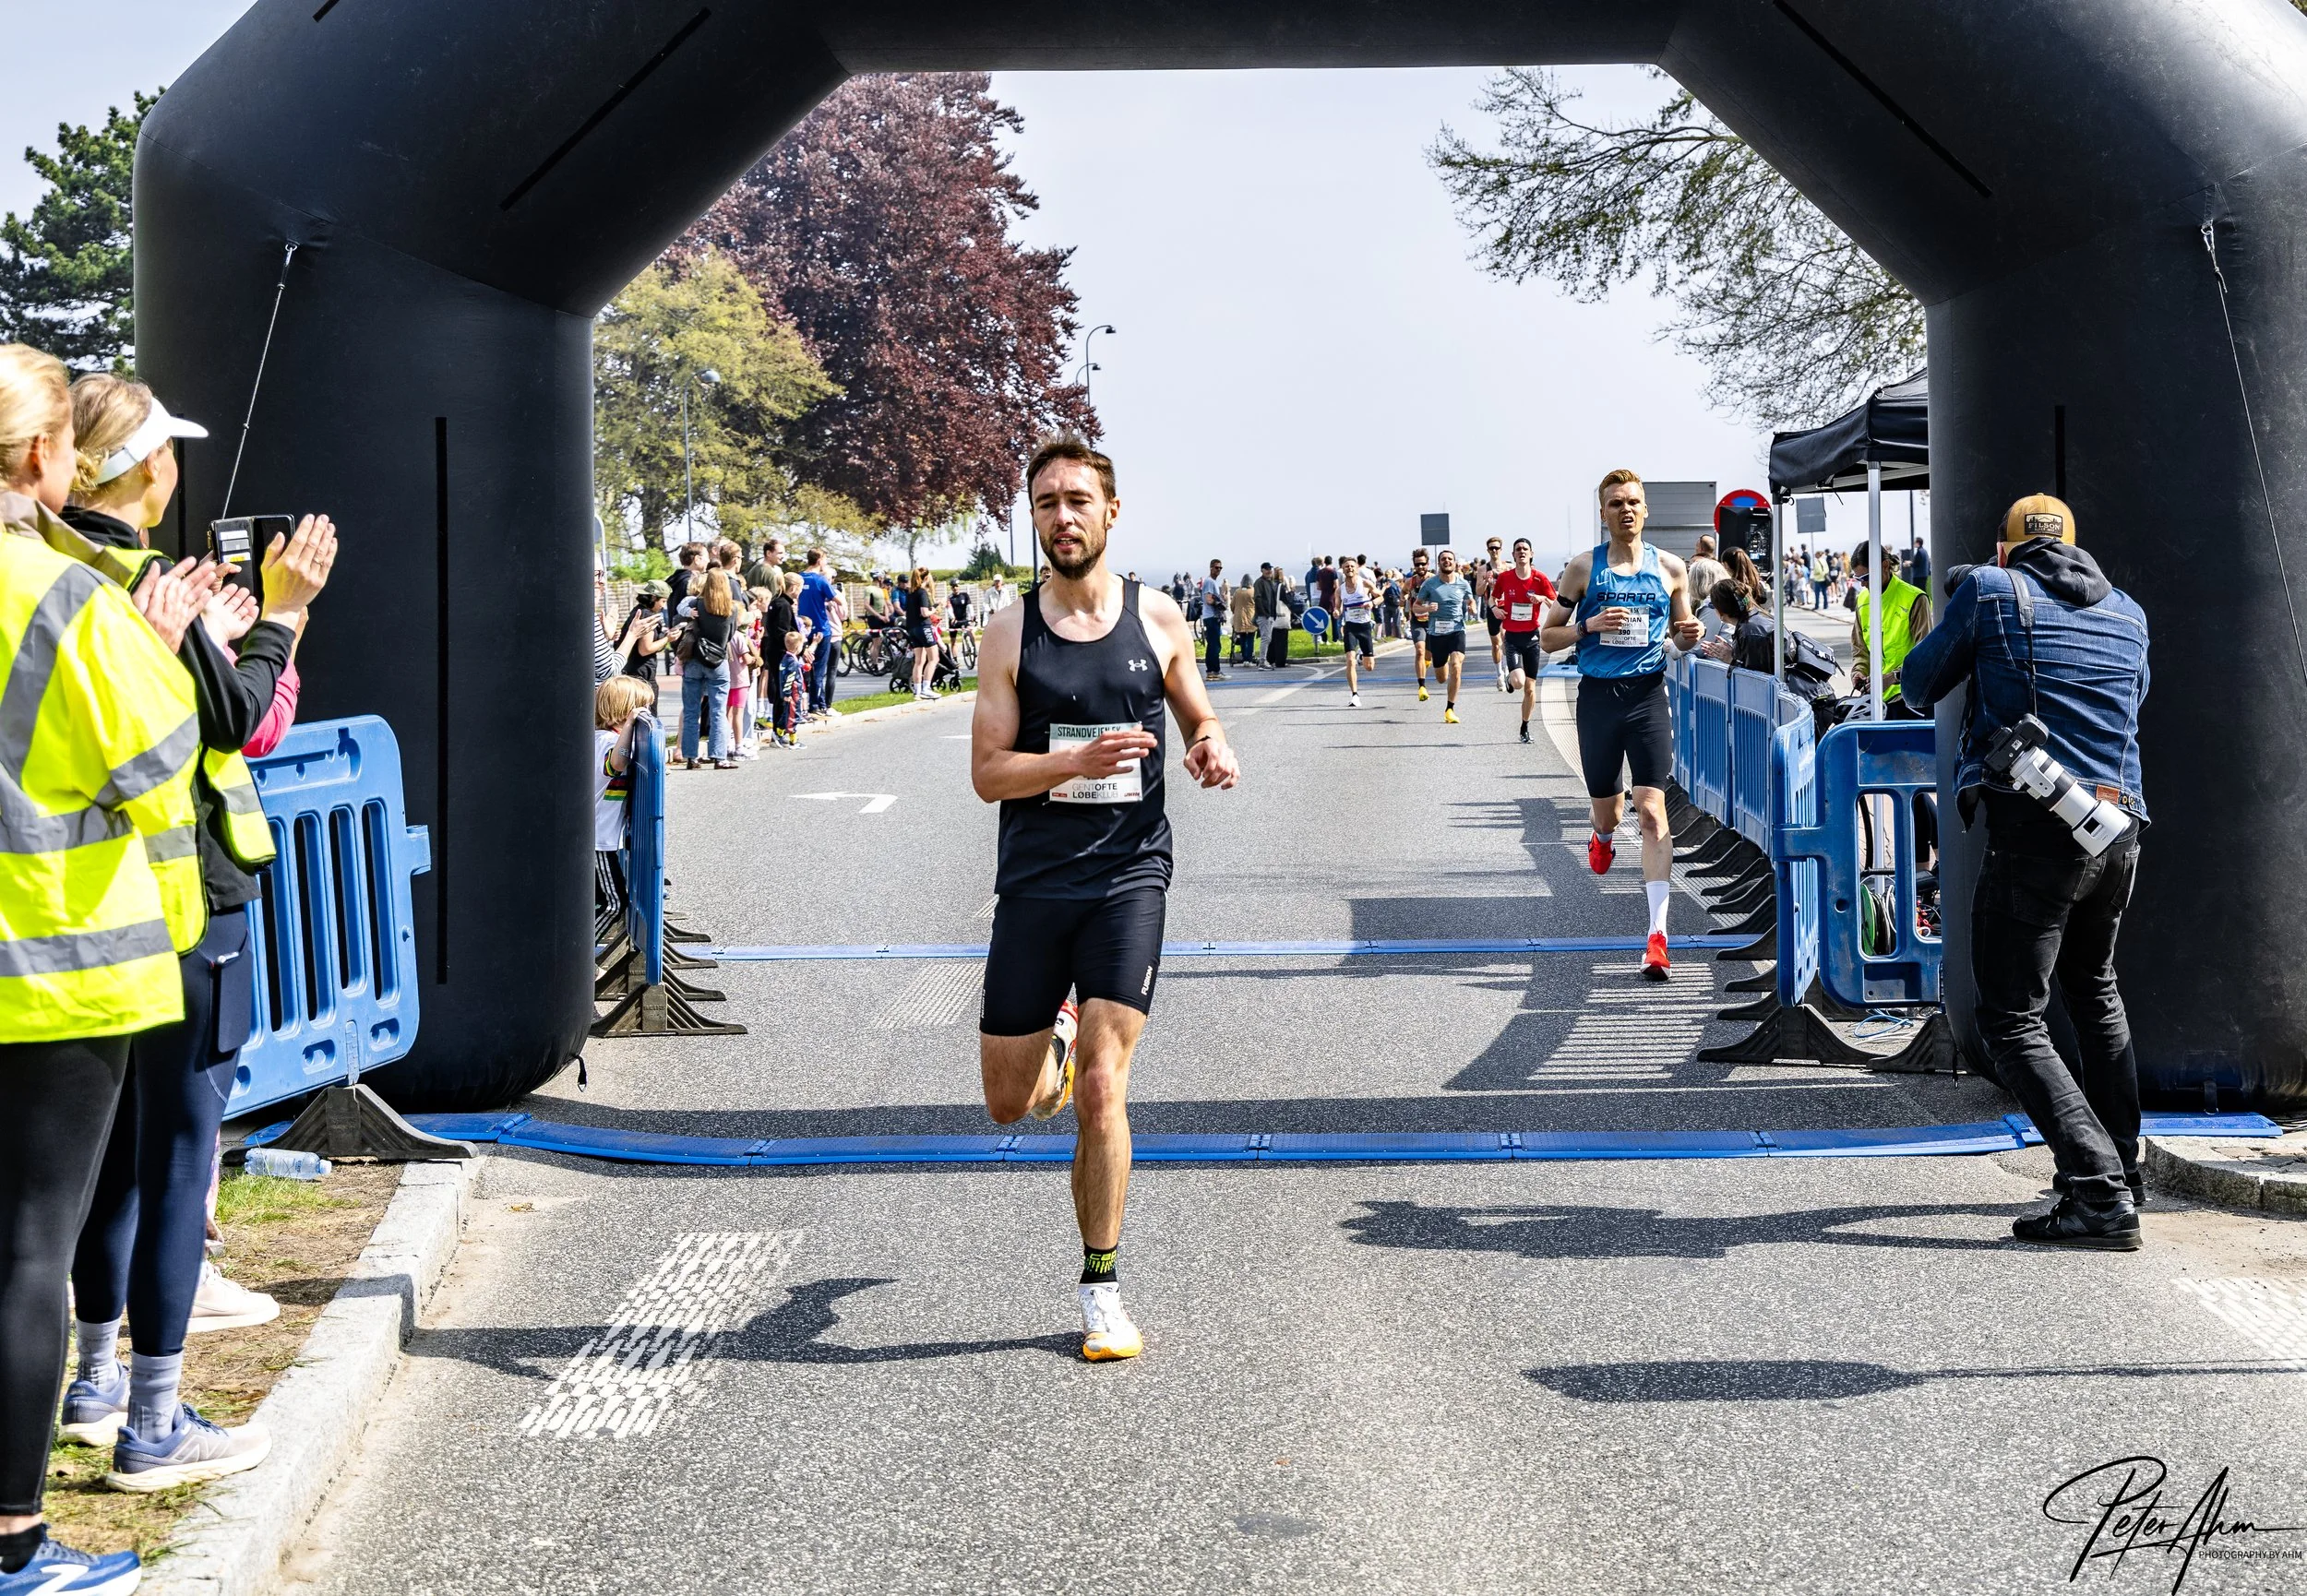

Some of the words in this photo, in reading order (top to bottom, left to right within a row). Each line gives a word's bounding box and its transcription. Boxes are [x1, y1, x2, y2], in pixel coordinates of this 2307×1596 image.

[2028, 522, 2061, 530] FILSON
[1596, 592, 1656, 601] SPARTA
[1141, 965, 1153, 995] FUSION
